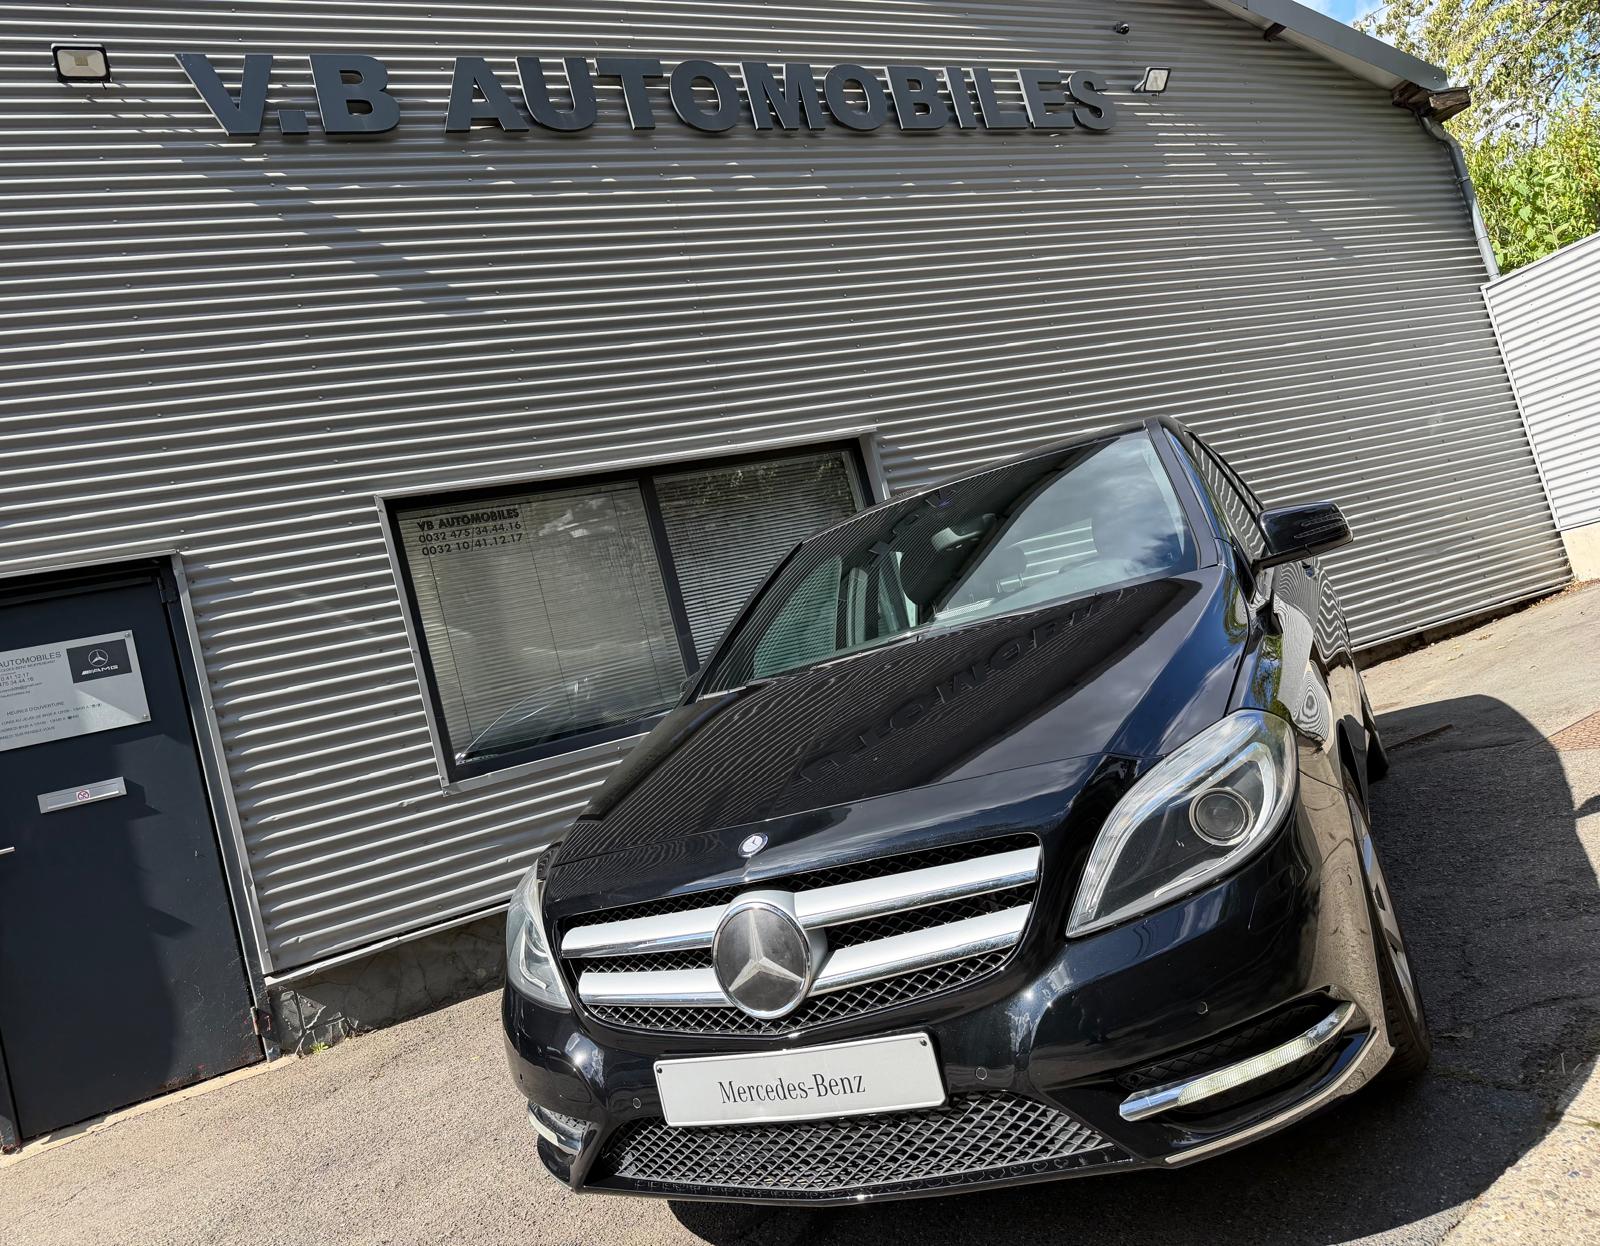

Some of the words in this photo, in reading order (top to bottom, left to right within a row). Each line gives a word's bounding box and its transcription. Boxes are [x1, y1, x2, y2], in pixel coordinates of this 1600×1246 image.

[174, 53, 400, 136] V.B
[445, 56, 1117, 133] AUTOMOBILES
[416, 520, 435, 532] VB
[439, 508, 520, 529] AUTOMOBILES
[418, 531, 447, 543] 0032
[422, 543, 452, 556] 0032
[718, 1073, 867, 1104] Mercedes-Benz
